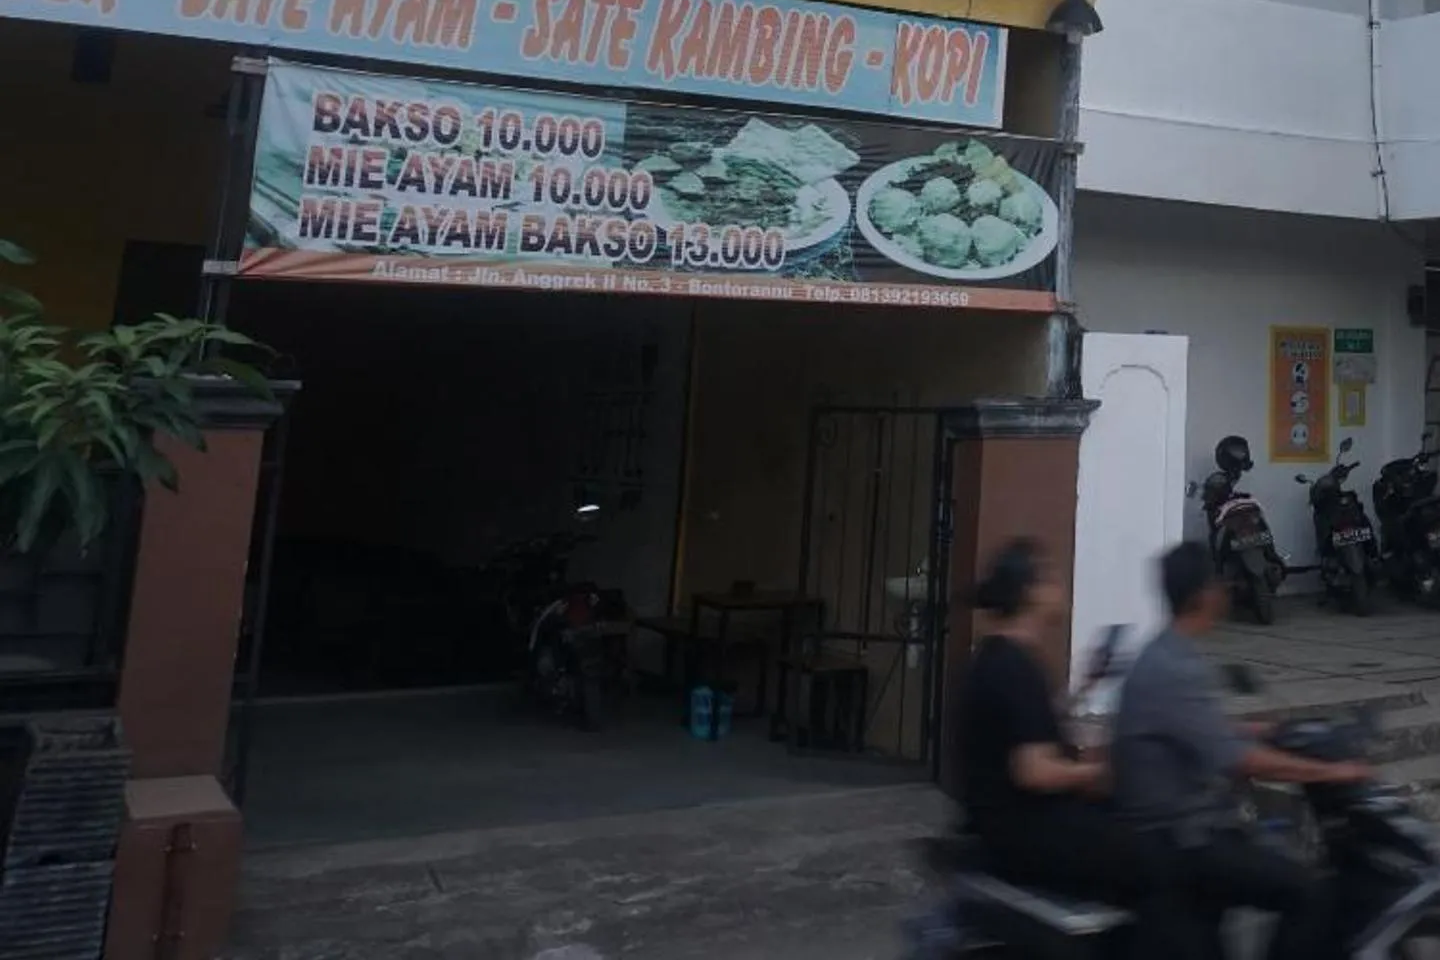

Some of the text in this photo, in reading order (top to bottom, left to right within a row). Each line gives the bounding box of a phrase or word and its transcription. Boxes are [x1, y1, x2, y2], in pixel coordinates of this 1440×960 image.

[889, 21, 988, 106] KOPI
[311, 92, 604, 158] BAKSO 10.000
[303, 144, 652, 211] MIE AYAM 10.000
[299, 197, 785, 270] MIE AYAM BAKSO 13.000
[371, 260, 449, 282] Alamat
[511, 269, 596, 289] Anggrek
